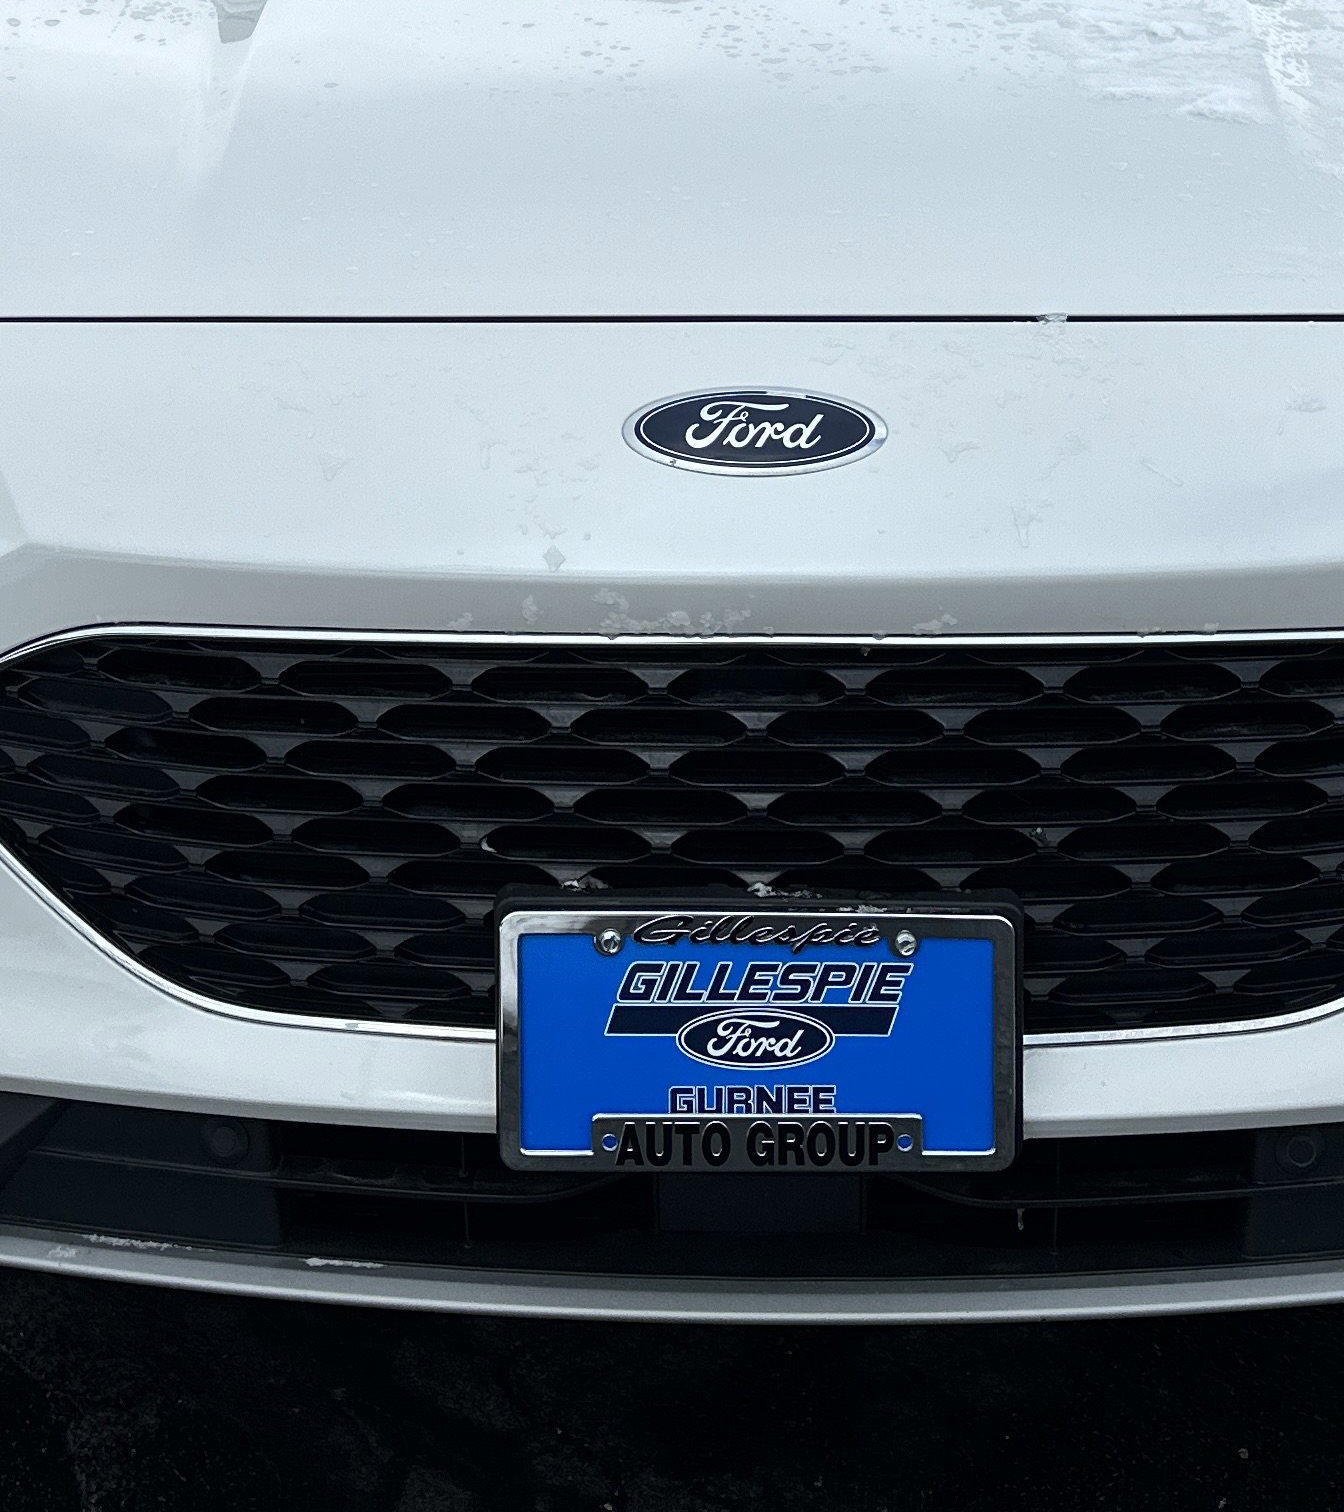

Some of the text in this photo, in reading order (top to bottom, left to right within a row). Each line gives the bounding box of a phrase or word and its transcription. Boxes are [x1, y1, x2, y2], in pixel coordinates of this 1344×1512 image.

[685, 401, 824, 449] Ford
[633, 914, 881, 955] Gillespie
[616, 960, 913, 1005] GILLESPIE
[706, 1018, 805, 1058] Ford
[668, 1084, 837, 1114] GURNEE
[615, 1120, 895, 1167] AUTO GROUP
